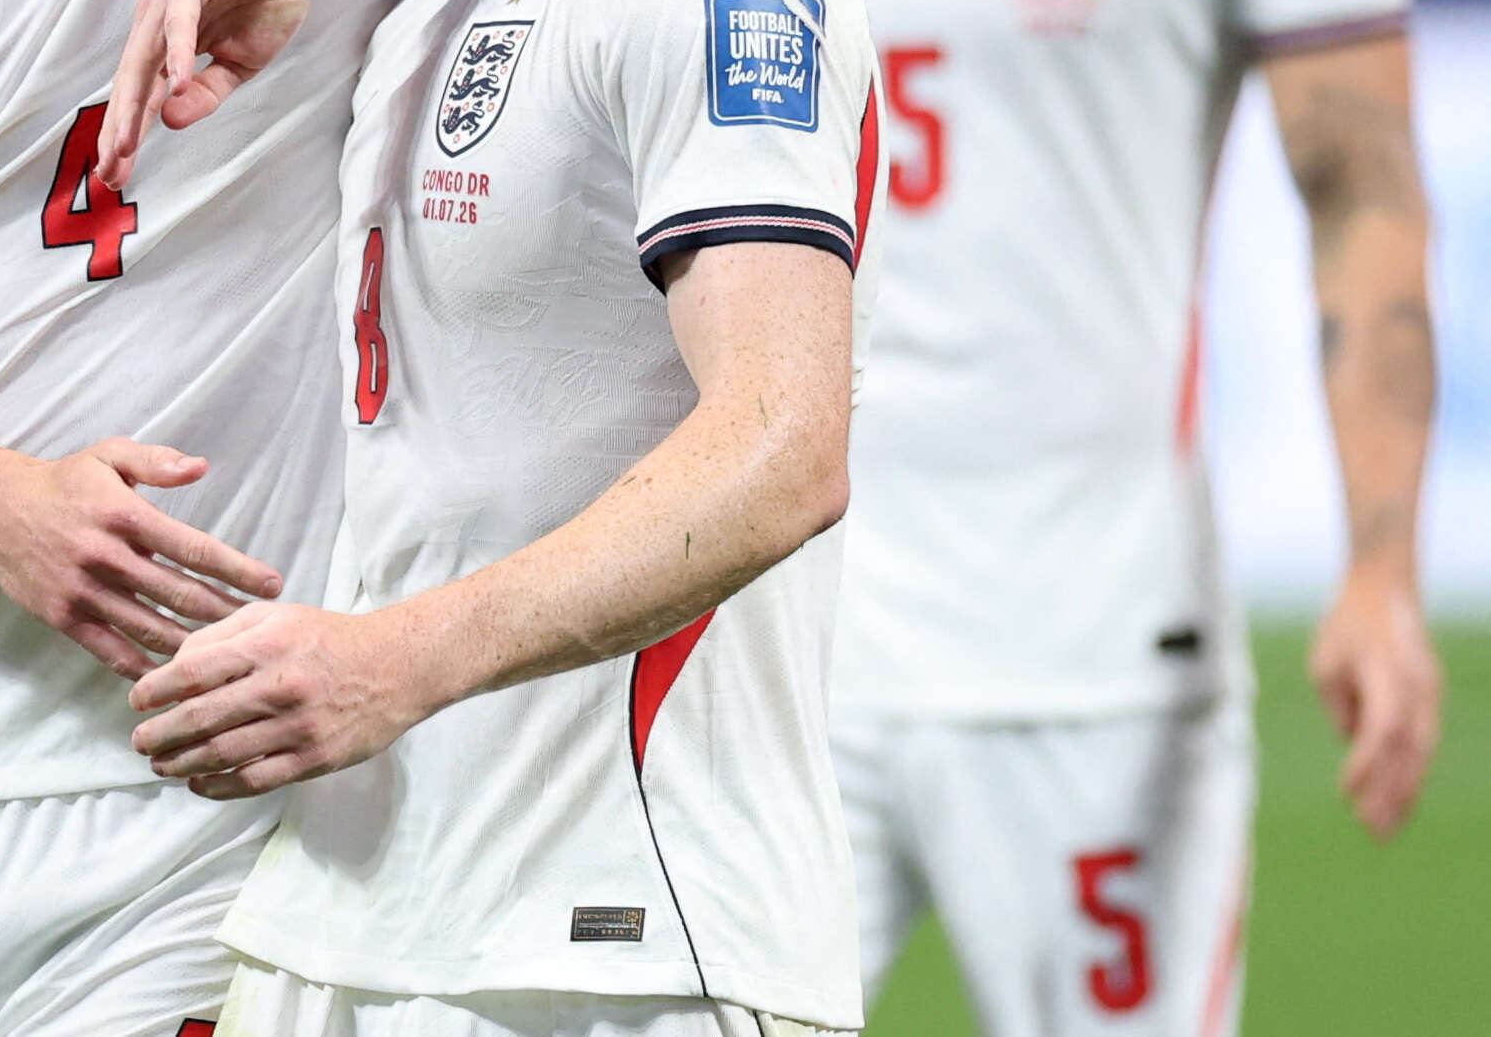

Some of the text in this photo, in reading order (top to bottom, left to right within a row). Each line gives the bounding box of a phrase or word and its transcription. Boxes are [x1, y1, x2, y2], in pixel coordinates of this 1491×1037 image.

[729, 10, 803, 37] FOOTBALL
[730, 31, 803, 65] UNITES
[725, 60, 806, 94] the World
[752, 88, 783, 103] FIFA
[883, 44, 946, 210] 5
[41, 101, 138, 282] 4
[423, 169, 490, 198] CONGO DR
[423, 197, 477, 225] 01.07.26
[353, 227, 389, 425] 8
[1073, 848, 1150, 1015] 5
